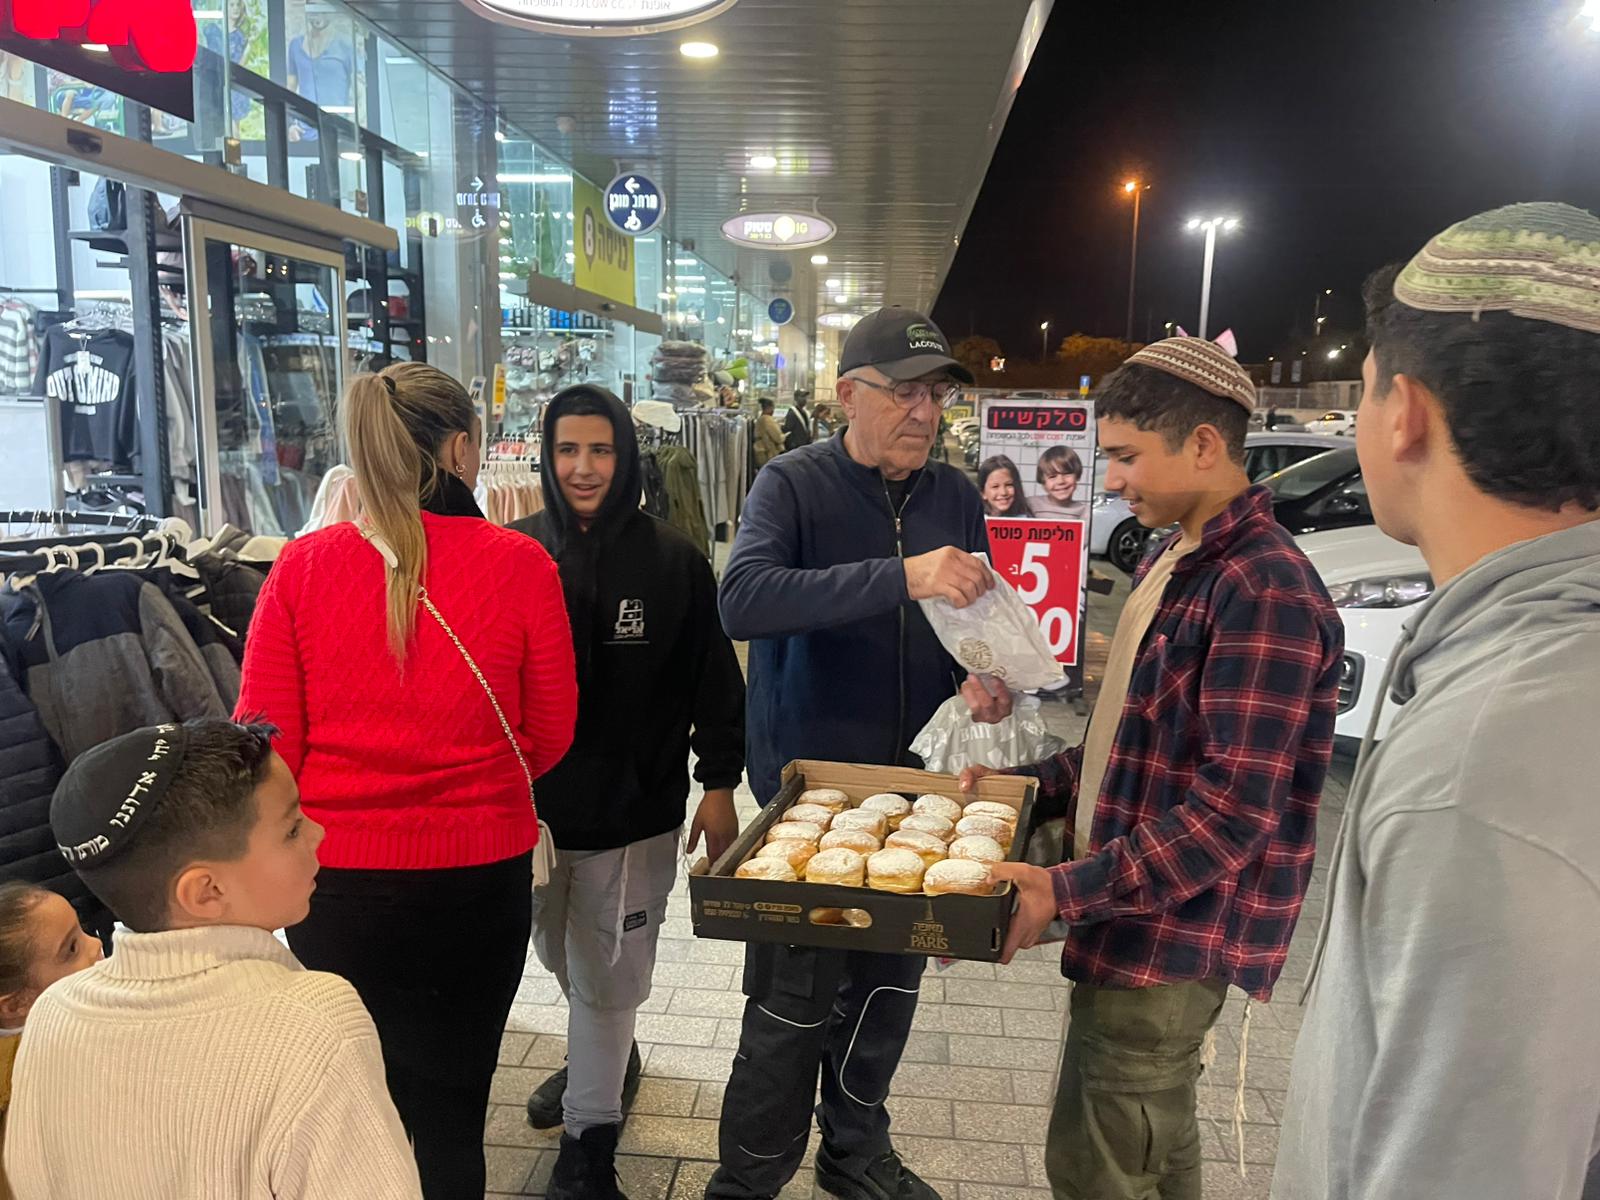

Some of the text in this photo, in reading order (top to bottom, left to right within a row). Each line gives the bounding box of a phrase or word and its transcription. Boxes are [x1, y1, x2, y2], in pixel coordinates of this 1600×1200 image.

[631, 193, 658, 209] מרחב
[992, 409, 1086, 429] סלקשיין
[990, 525, 1074, 542] חליפות פוטר
[1017, 542, 1051, 605] 5
[1026, 605, 1073, 657] 0
[109, 770, 158, 828] אדוננו
[910, 935, 949, 950] PARIS
